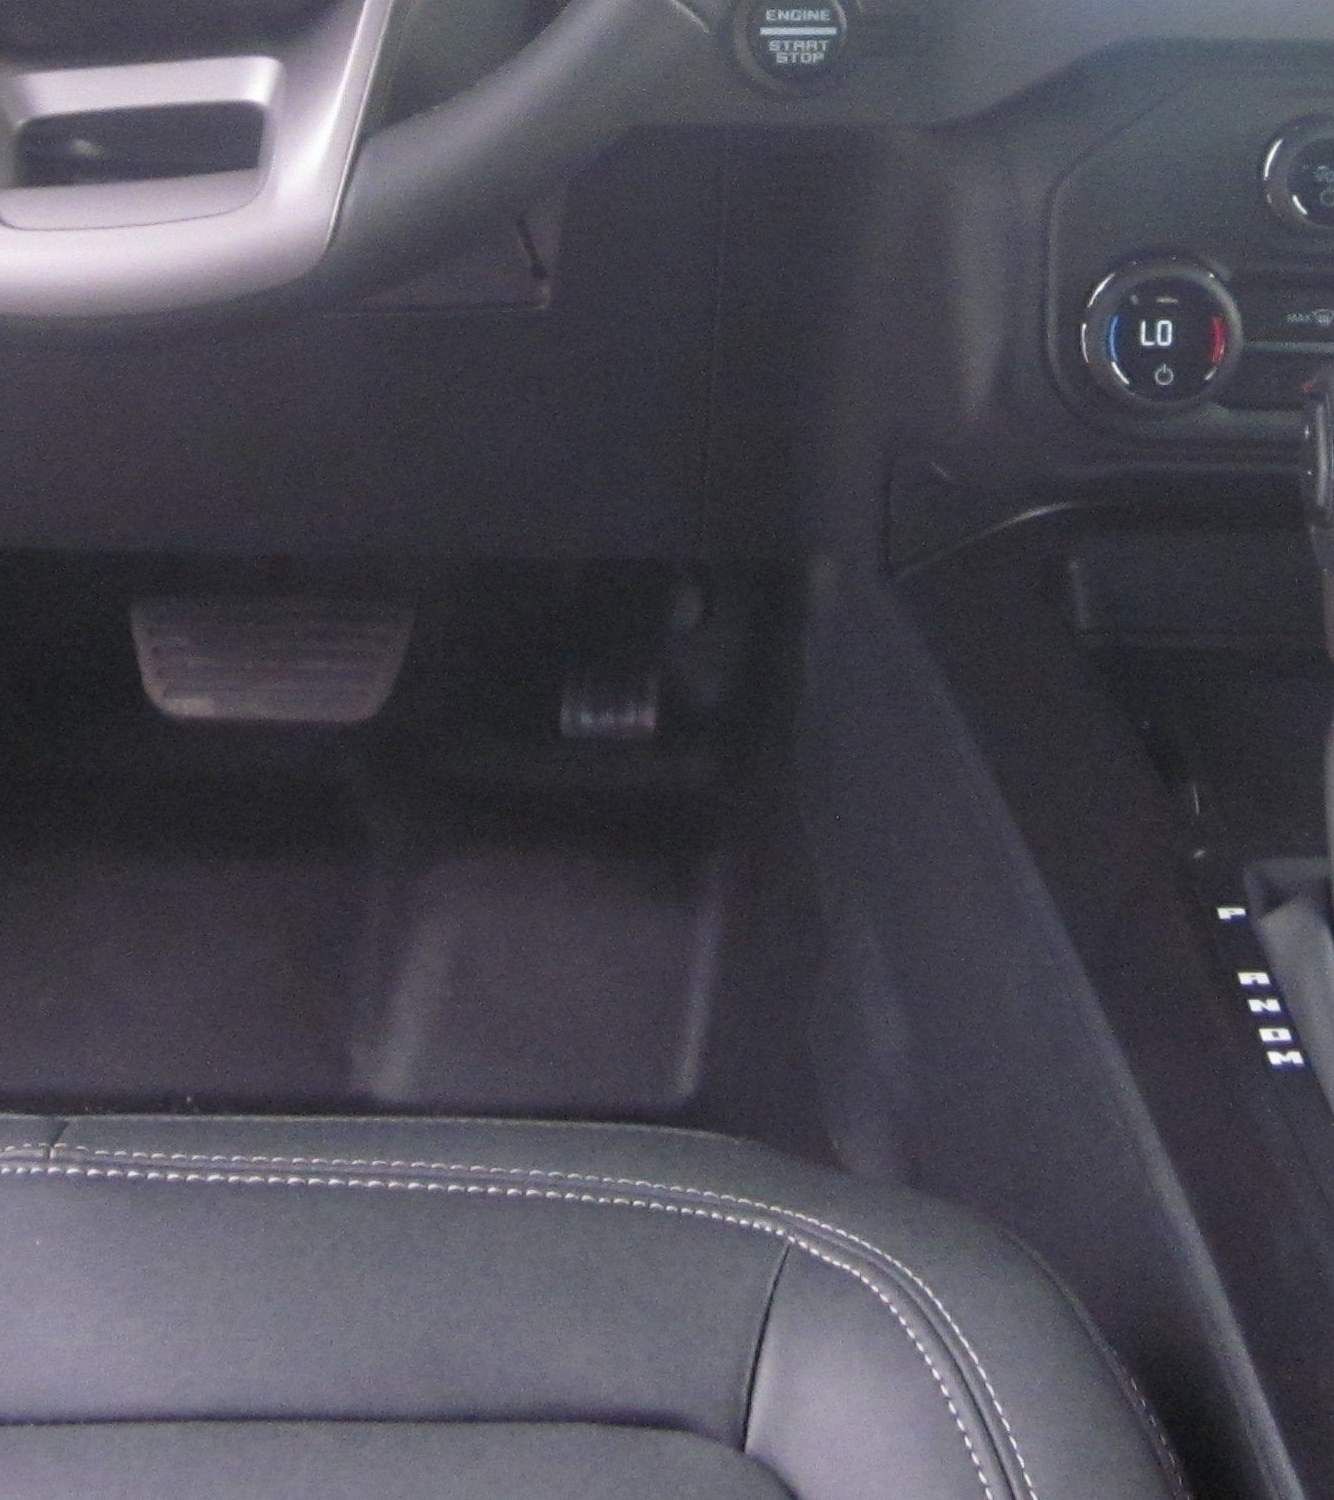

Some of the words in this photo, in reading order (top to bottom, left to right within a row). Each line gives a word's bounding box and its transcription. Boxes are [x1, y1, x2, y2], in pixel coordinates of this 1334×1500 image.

[765, 9, 832, 22] ENGINE
[768, 40, 830, 52] START
[775, 52, 826, 65] STOP
[1139, 319, 1173, 347] LO
[1217, 907, 1247, 920] P
[1247, 999, 1282, 1013] N
[1267, 1051, 1305, 1066] M
